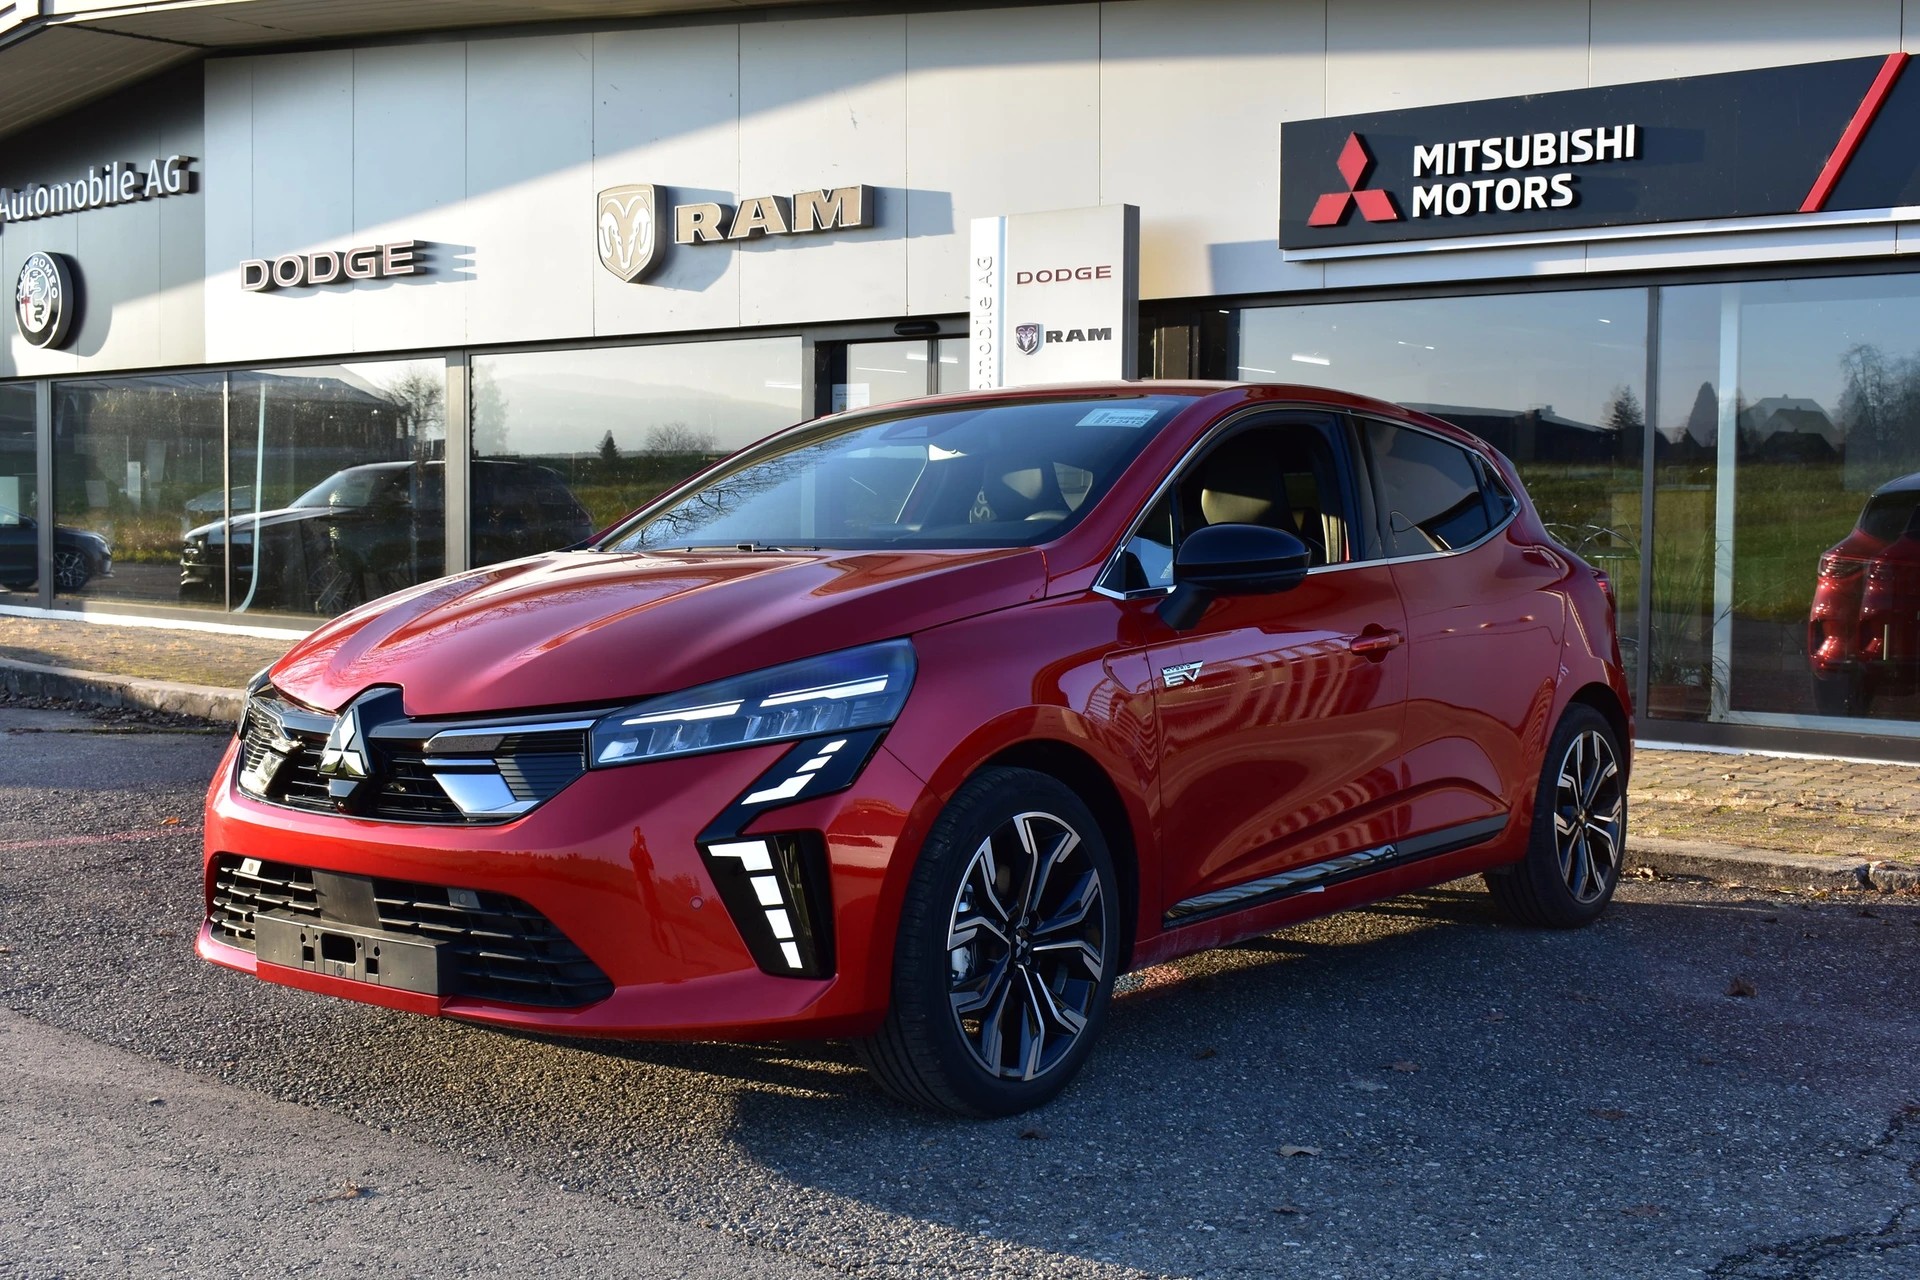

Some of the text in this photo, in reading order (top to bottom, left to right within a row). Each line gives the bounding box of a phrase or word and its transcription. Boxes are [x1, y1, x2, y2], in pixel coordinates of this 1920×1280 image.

[1413, 124, 1637, 177] MITSUBISHI
[145, 155, 185, 197] AG
[1413, 173, 1574, 218] MOTORS
[674, 184, 864, 244] RAM
[32, 257, 59, 299] ROMEO
[240, 240, 416, 292] DODGE
[977, 256, 993, 288] AG
[1016, 265, 1112, 285] DODGE
[1045, 327, 1112, 344] RAM
[1163, 666, 1202, 688] EV
